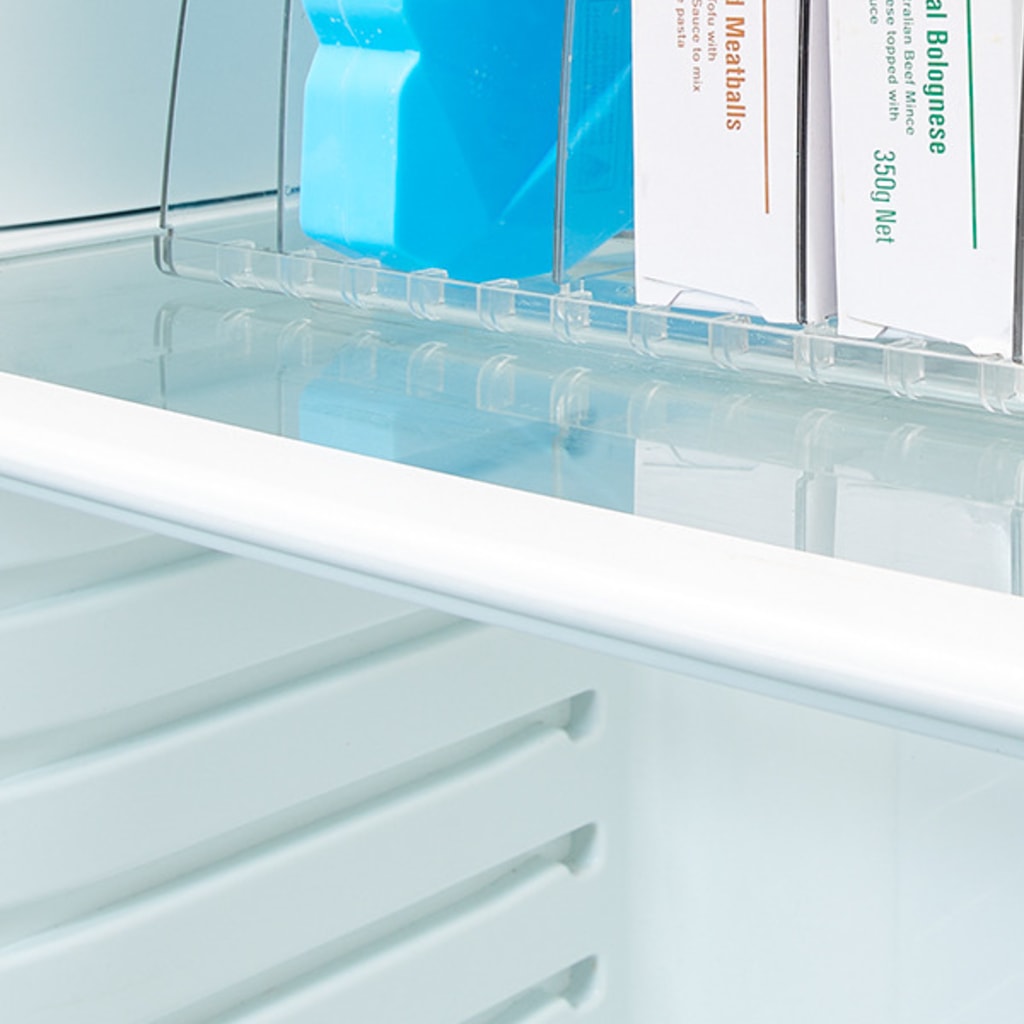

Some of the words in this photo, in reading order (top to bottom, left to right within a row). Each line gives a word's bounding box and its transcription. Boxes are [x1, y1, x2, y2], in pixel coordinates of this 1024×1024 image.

[675, 7, 687, 48] pasta
[707, 30, 718, 62] with
[692, 48, 702, 62] to
[725, 16, 746, 131] Meatballs
[885, 30, 899, 85] topped
[903, 50, 916, 85] Beef
[692, 67, 703, 92] mix
[923, 29, 949, 155] Bolognese
[888, 89, 900, 121] with
[905, 91, 917, 135] Mince
[870, 149, 896, 202] 350g
[875, 208, 896, 244] Net
